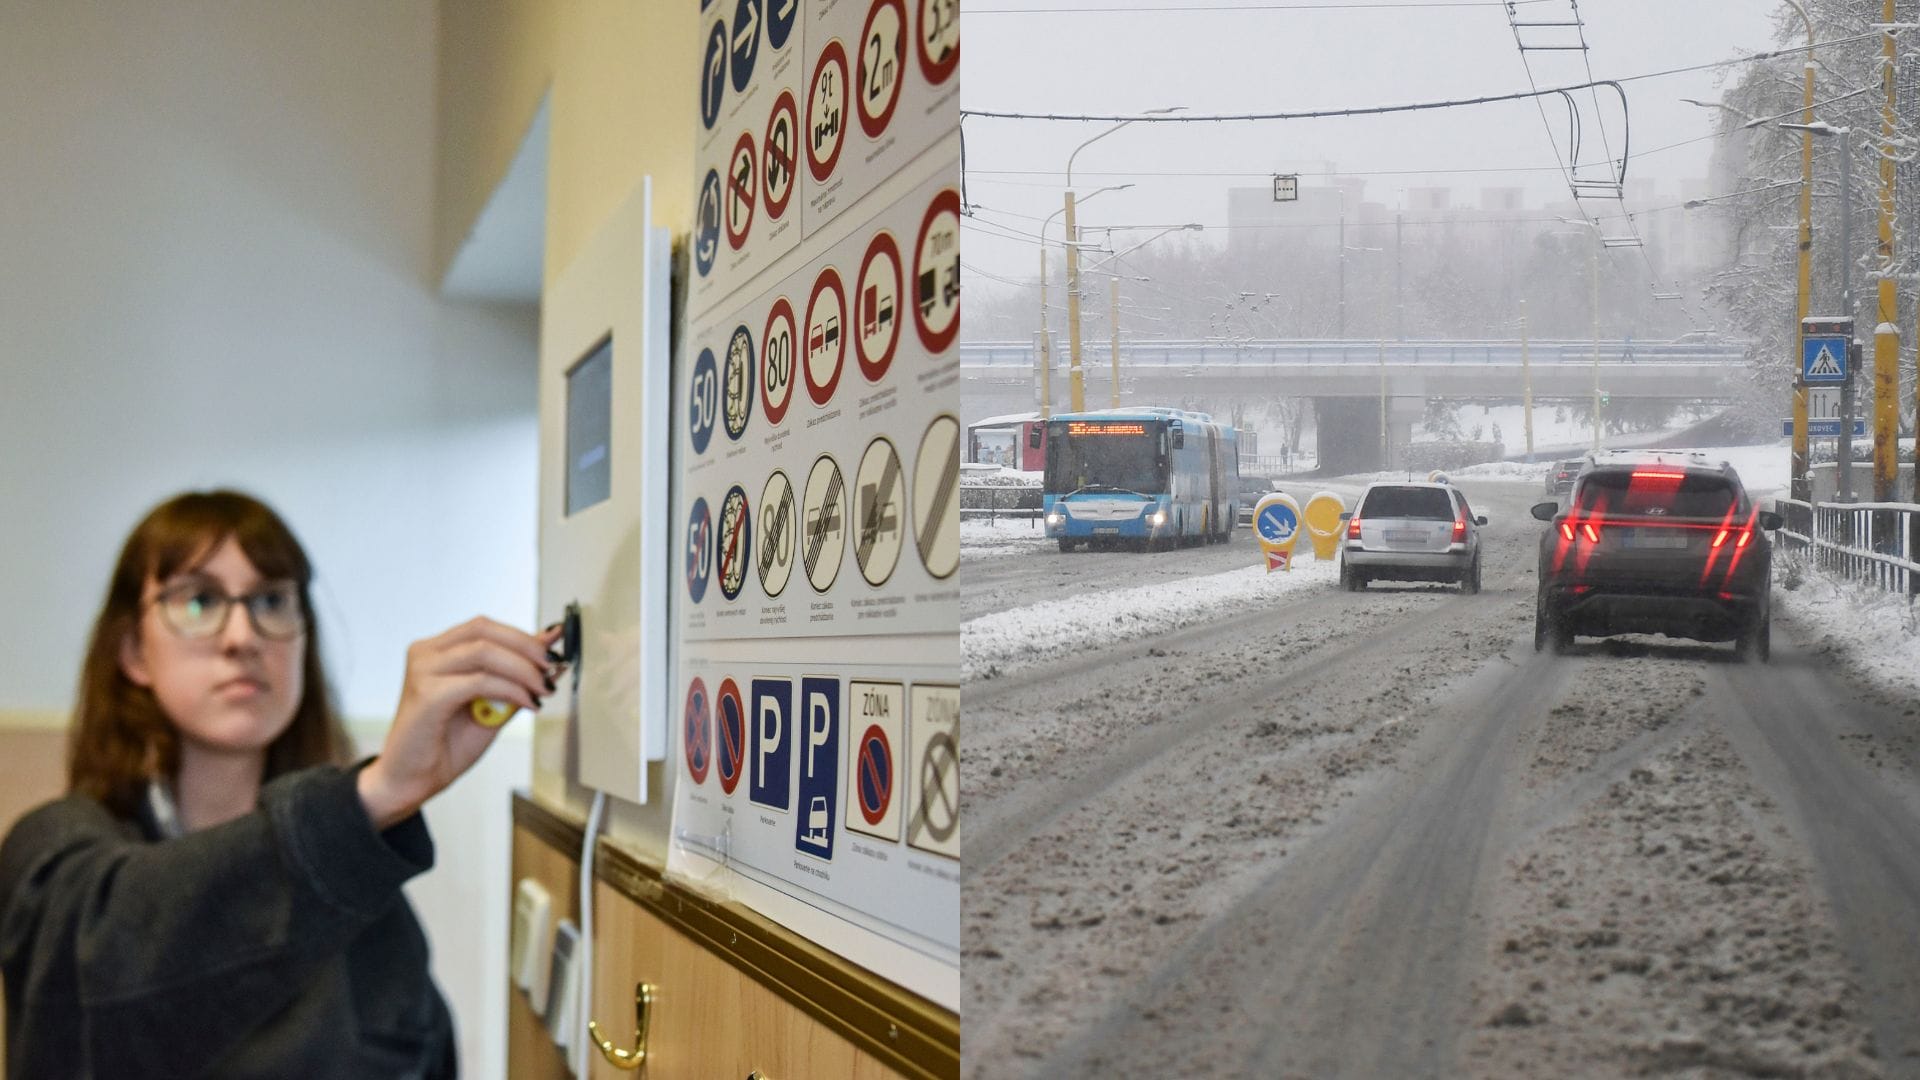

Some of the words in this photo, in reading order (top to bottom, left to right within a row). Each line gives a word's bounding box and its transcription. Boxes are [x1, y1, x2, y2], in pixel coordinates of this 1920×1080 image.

[767, 330, 789, 393] 80
[692, 368, 715, 434] 50
[689, 519, 709, 580] 50
[762, 503, 789, 570] 80
[808, 692, 831, 778] P
[863, 687, 889, 718] ZÓNA
[759, 695, 782, 788] P
